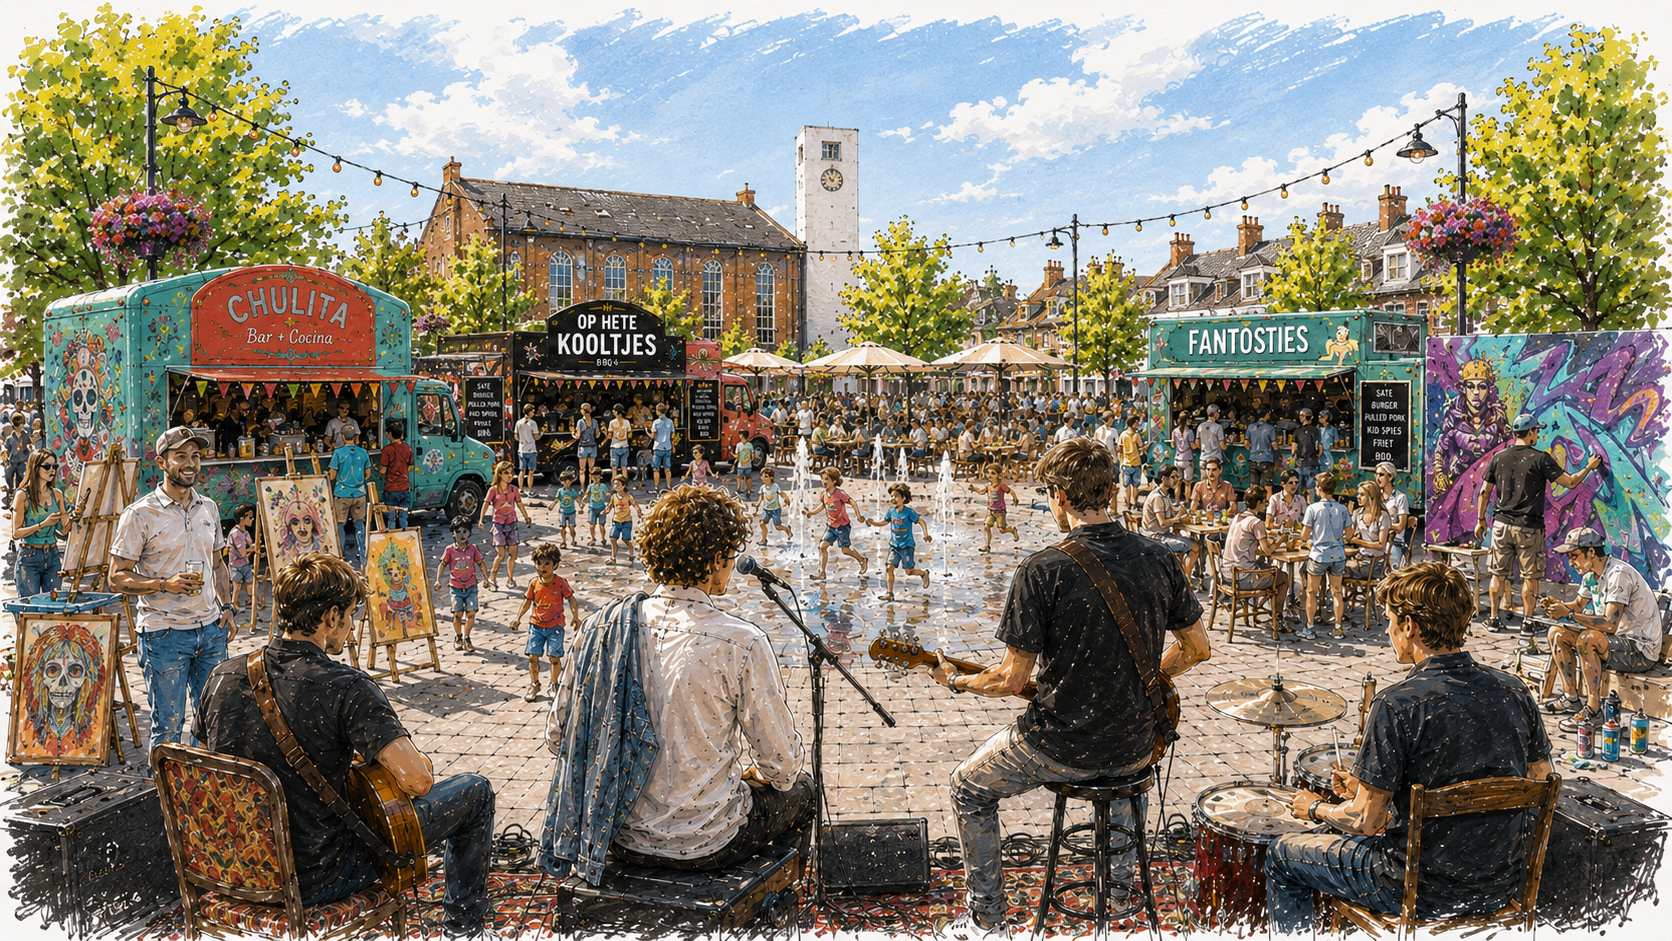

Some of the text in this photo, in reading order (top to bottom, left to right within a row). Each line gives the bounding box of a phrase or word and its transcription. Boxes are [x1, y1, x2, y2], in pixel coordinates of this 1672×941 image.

[227, 286, 349, 330] CHULITA
[577, 313, 638, 330] OP HETE
[246, 327, 273, 344] Bar
[289, 328, 333, 345] Cocina
[557, 333, 657, 356] KOOLTJES
[1188, 325, 1309, 355] FANTOSTIES
[1375, 389, 1393, 398] SATE
[1388, 413, 1406, 422] PORK
